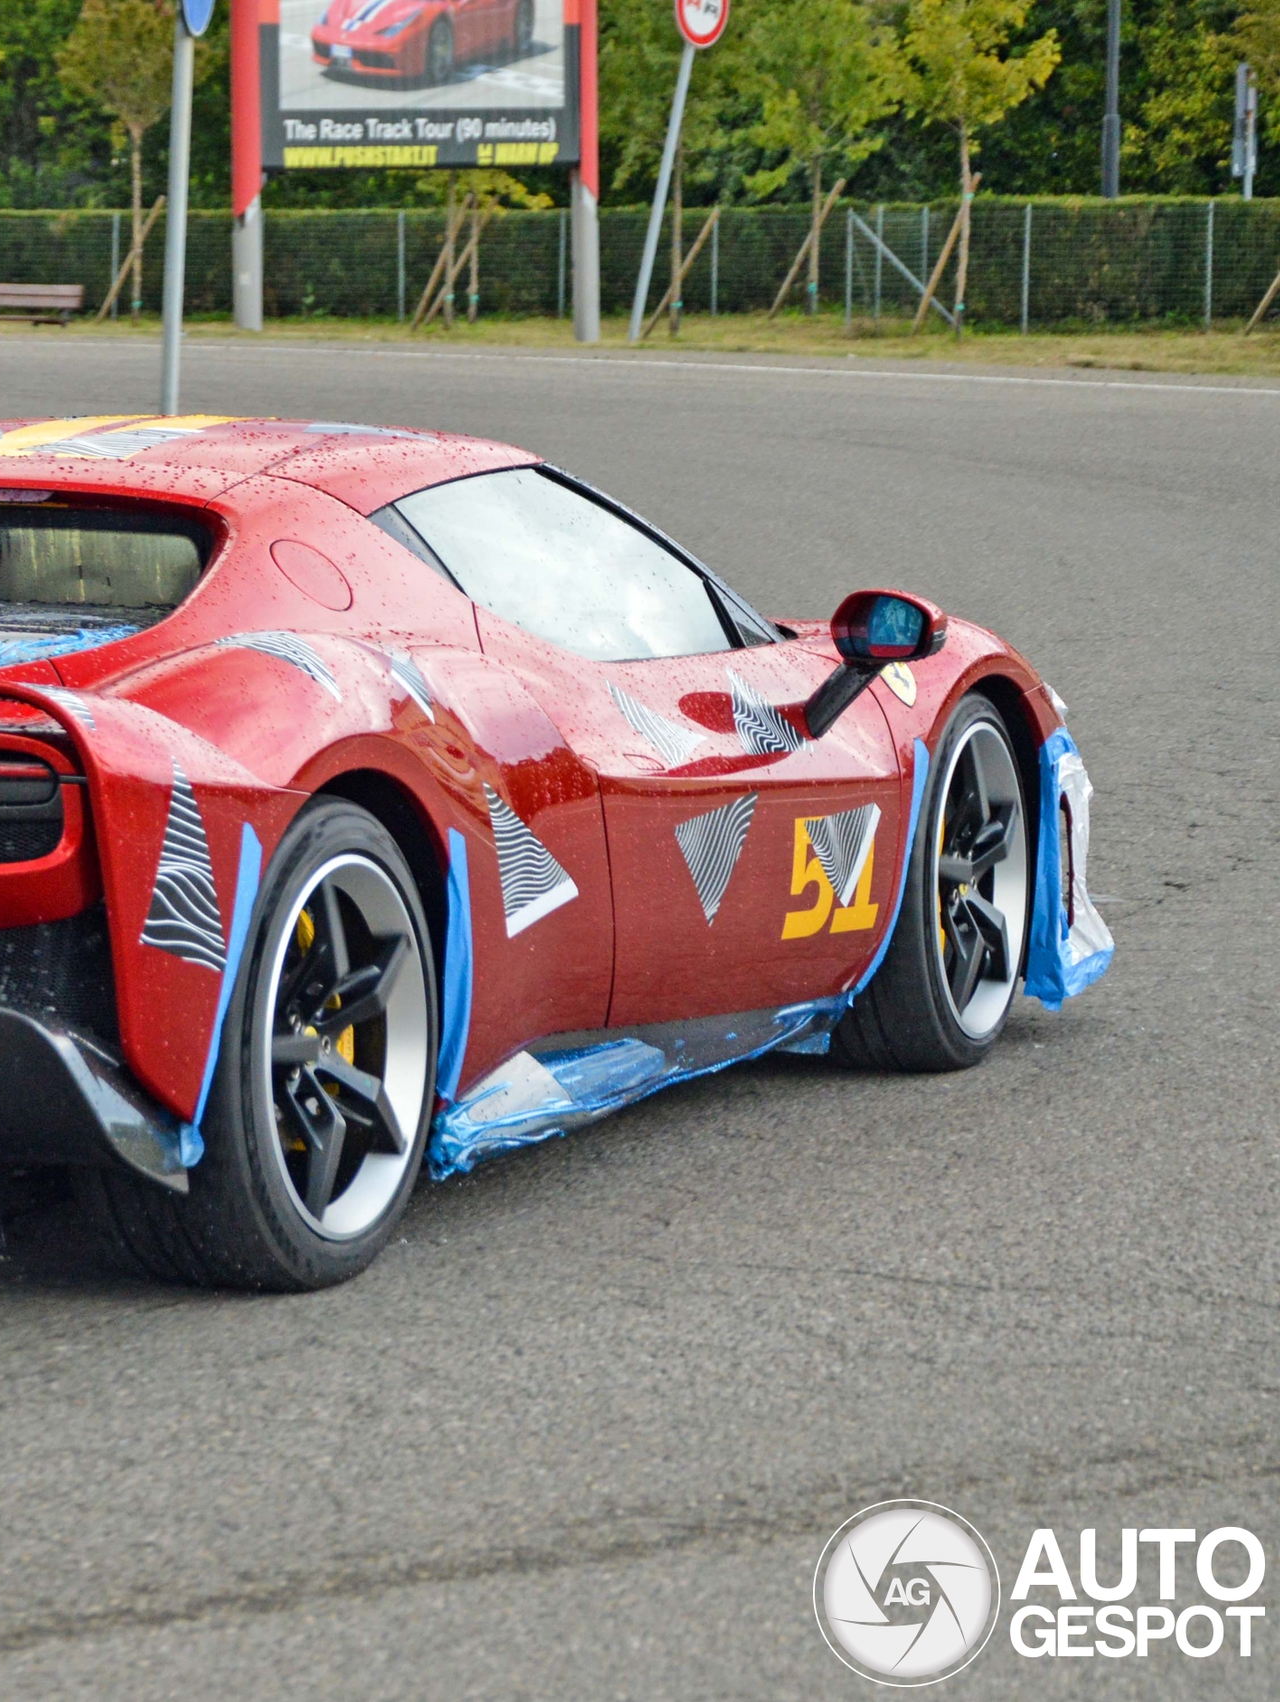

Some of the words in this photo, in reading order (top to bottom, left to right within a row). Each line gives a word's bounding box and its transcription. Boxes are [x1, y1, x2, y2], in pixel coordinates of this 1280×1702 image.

[283, 119, 317, 140] The
[320, 119, 364, 140] Race
[365, 118, 413, 140] Track
[415, 118, 454, 140] Tour
[456, 117, 483, 142] (90
[485, 117, 556, 141] minutes)
[781, 815, 879, 940] 51
